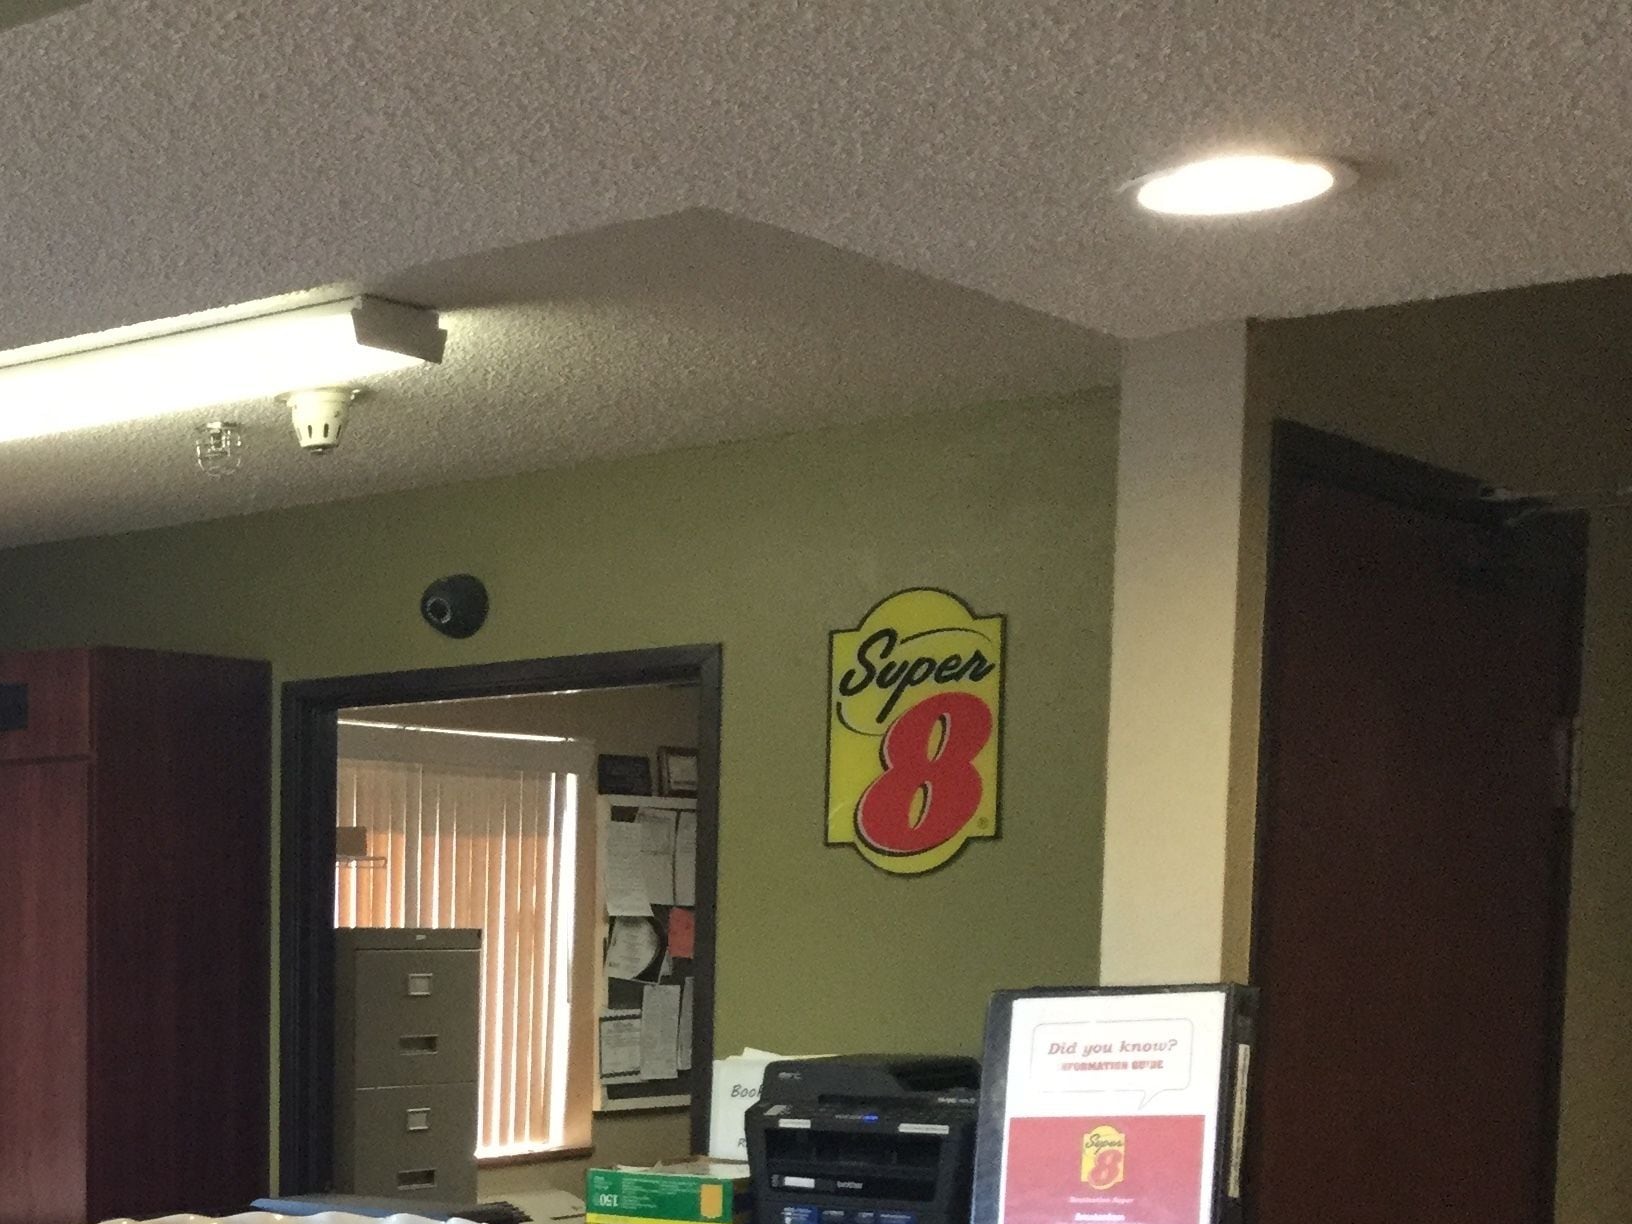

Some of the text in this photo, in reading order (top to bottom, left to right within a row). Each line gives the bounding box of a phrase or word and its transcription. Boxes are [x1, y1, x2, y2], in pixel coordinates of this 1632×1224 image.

[838, 628, 996, 724] Super
[853, 691, 994, 858] 8
[1048, 1038, 1179, 1058] Did you know?
[1058, 1060, 1129, 1072] NFORMATION
[1084, 1132, 1125, 1156] Super
[1087, 1148, 1124, 1188] 8
